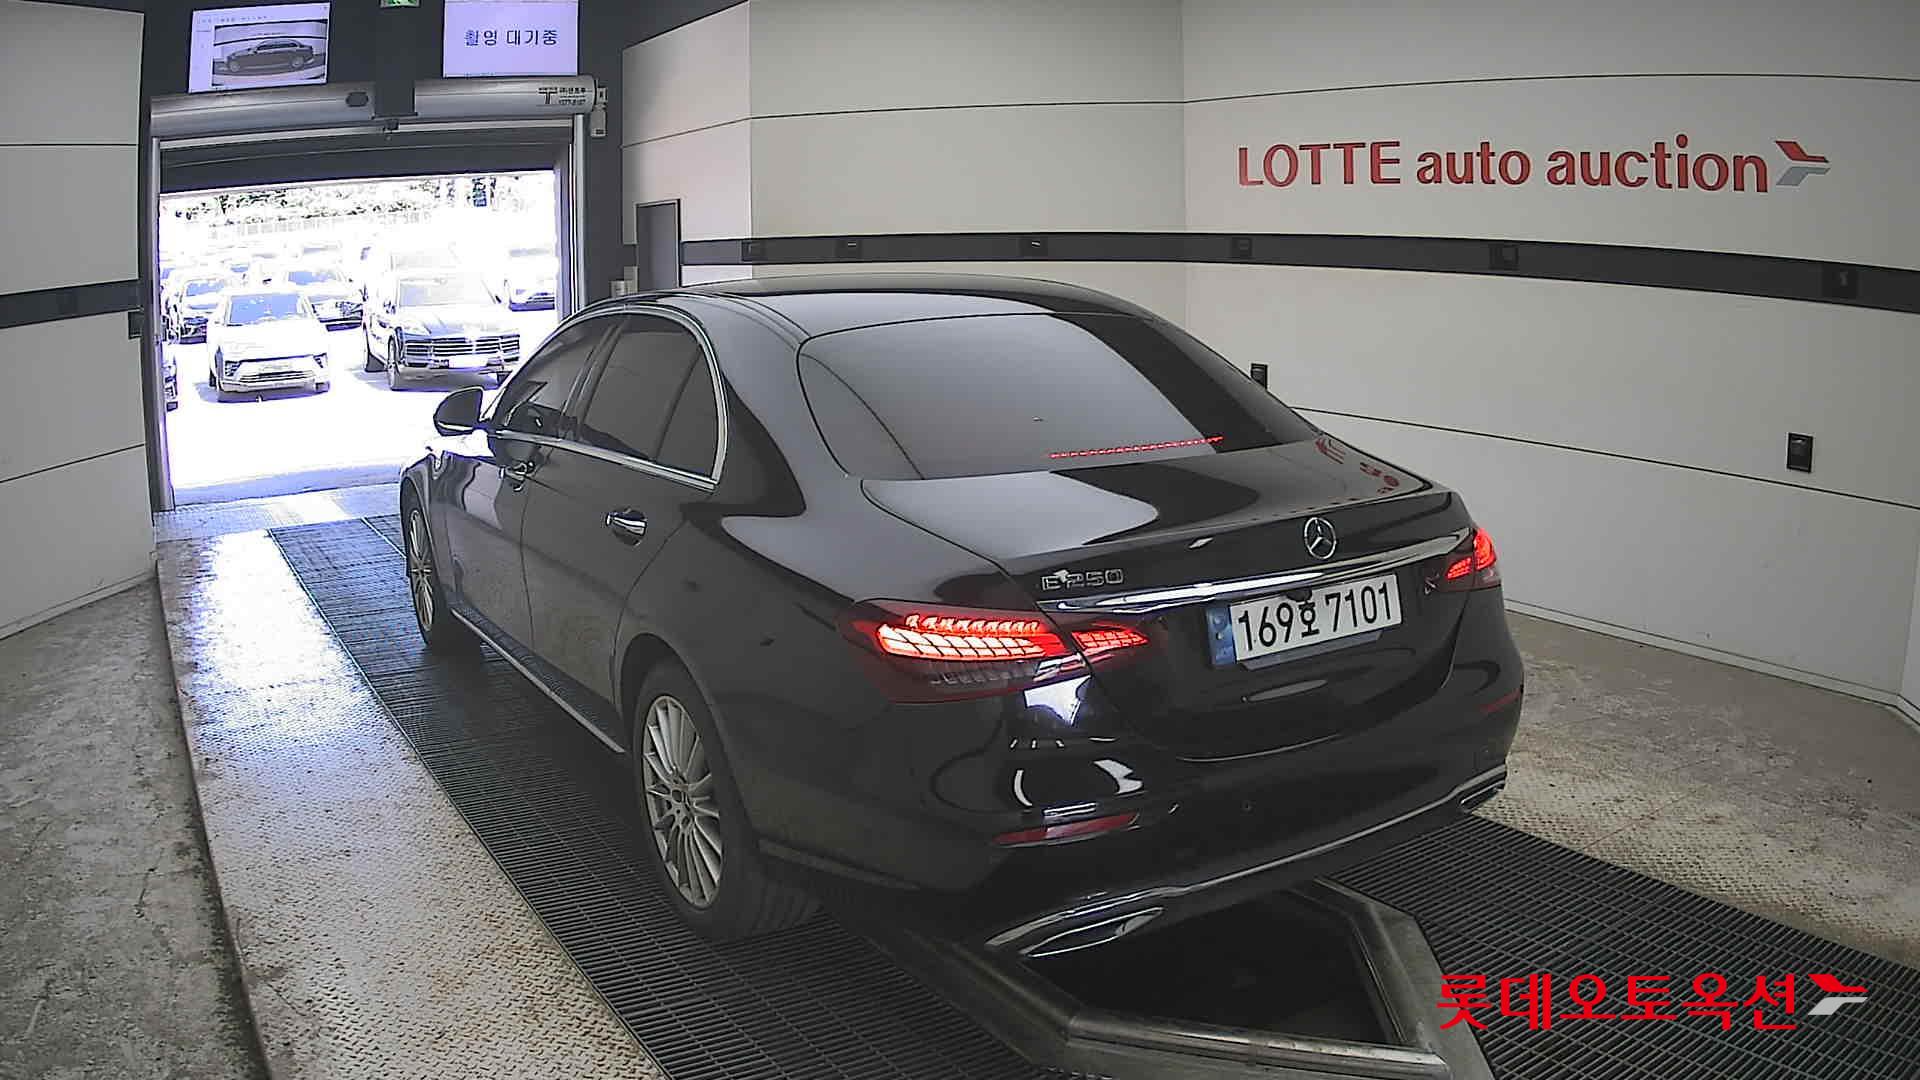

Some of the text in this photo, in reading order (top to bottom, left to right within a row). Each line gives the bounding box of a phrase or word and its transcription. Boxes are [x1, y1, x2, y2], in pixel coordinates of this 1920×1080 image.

[506, 29, 558, 46] 대기중
[1238, 133, 1768, 193] LOTTE auto auction
[1325, 581, 1391, 633] 7101
